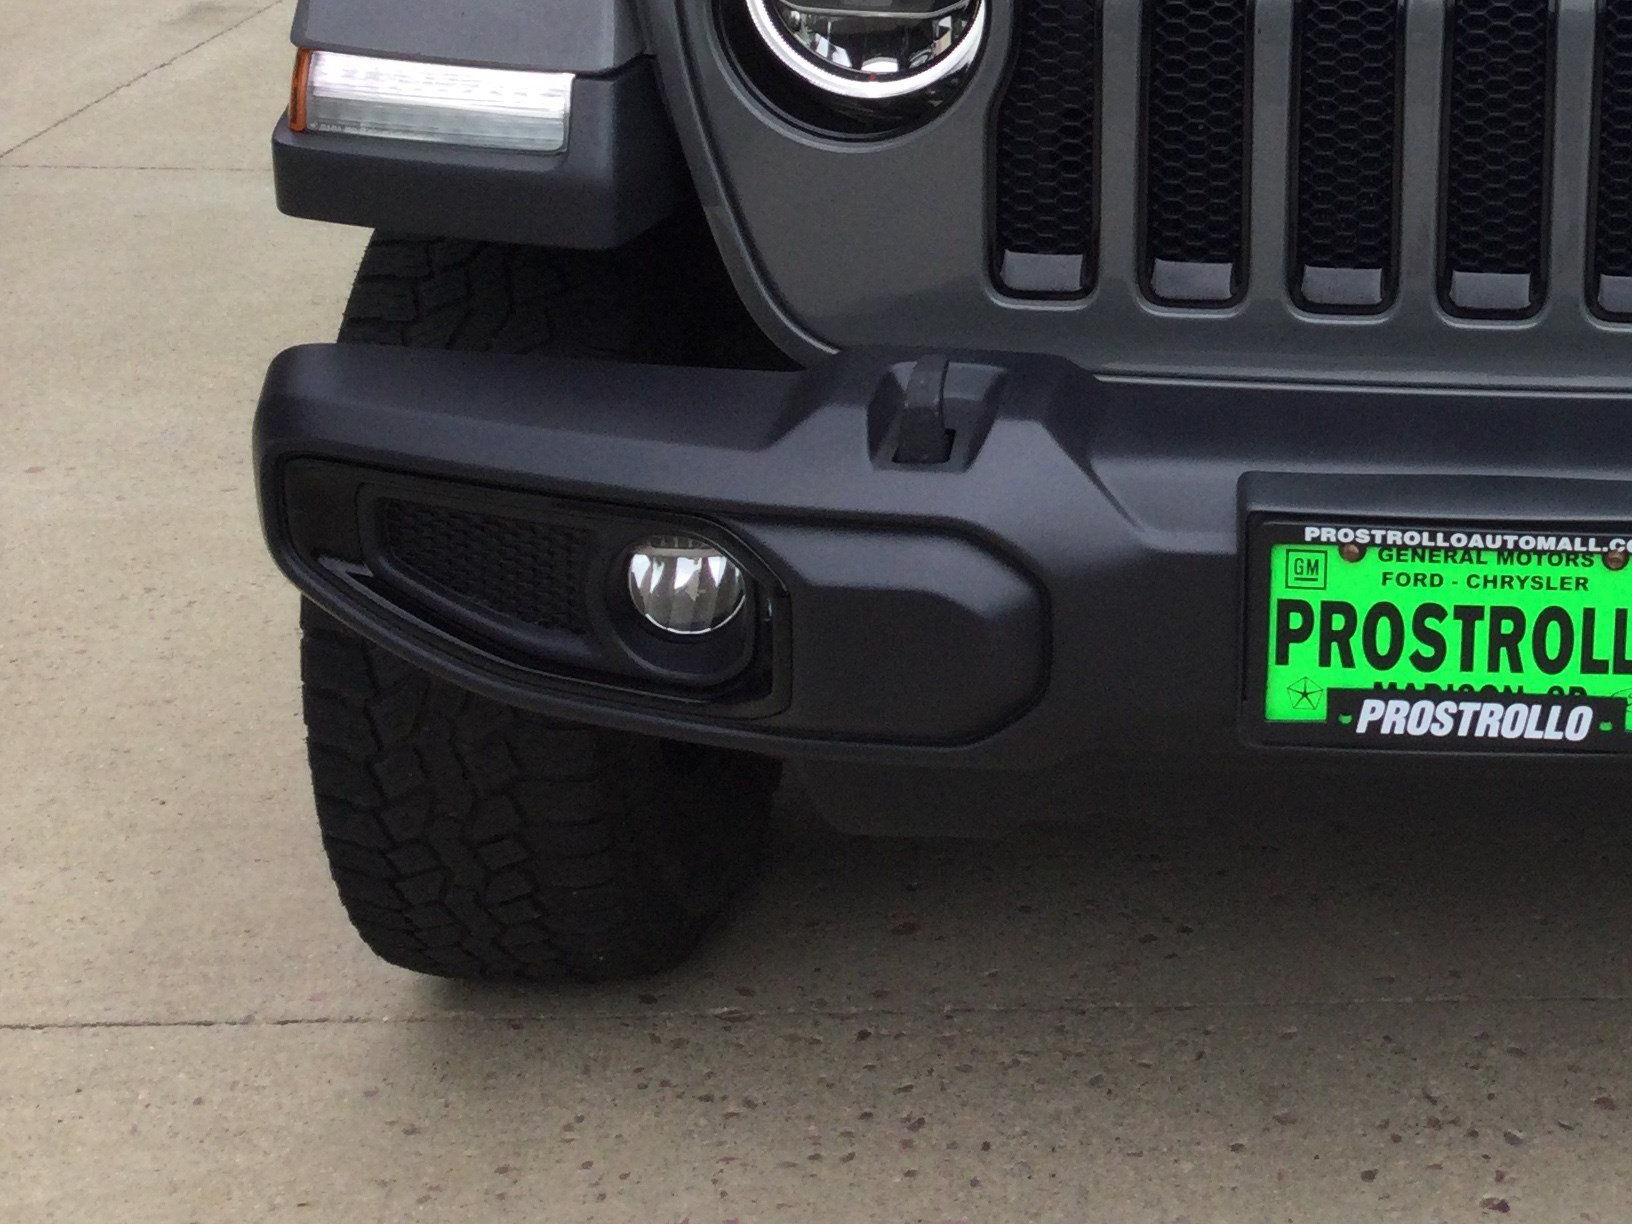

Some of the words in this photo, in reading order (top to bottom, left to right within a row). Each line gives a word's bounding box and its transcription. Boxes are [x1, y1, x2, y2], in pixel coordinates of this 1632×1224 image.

[1294, 557, 1320, 576] GM
[1381, 572, 1444, 588] FORD
[1466, 574, 1589, 591] CHRYSLER
[1356, 699, 1594, 742] PROSTROLLO
